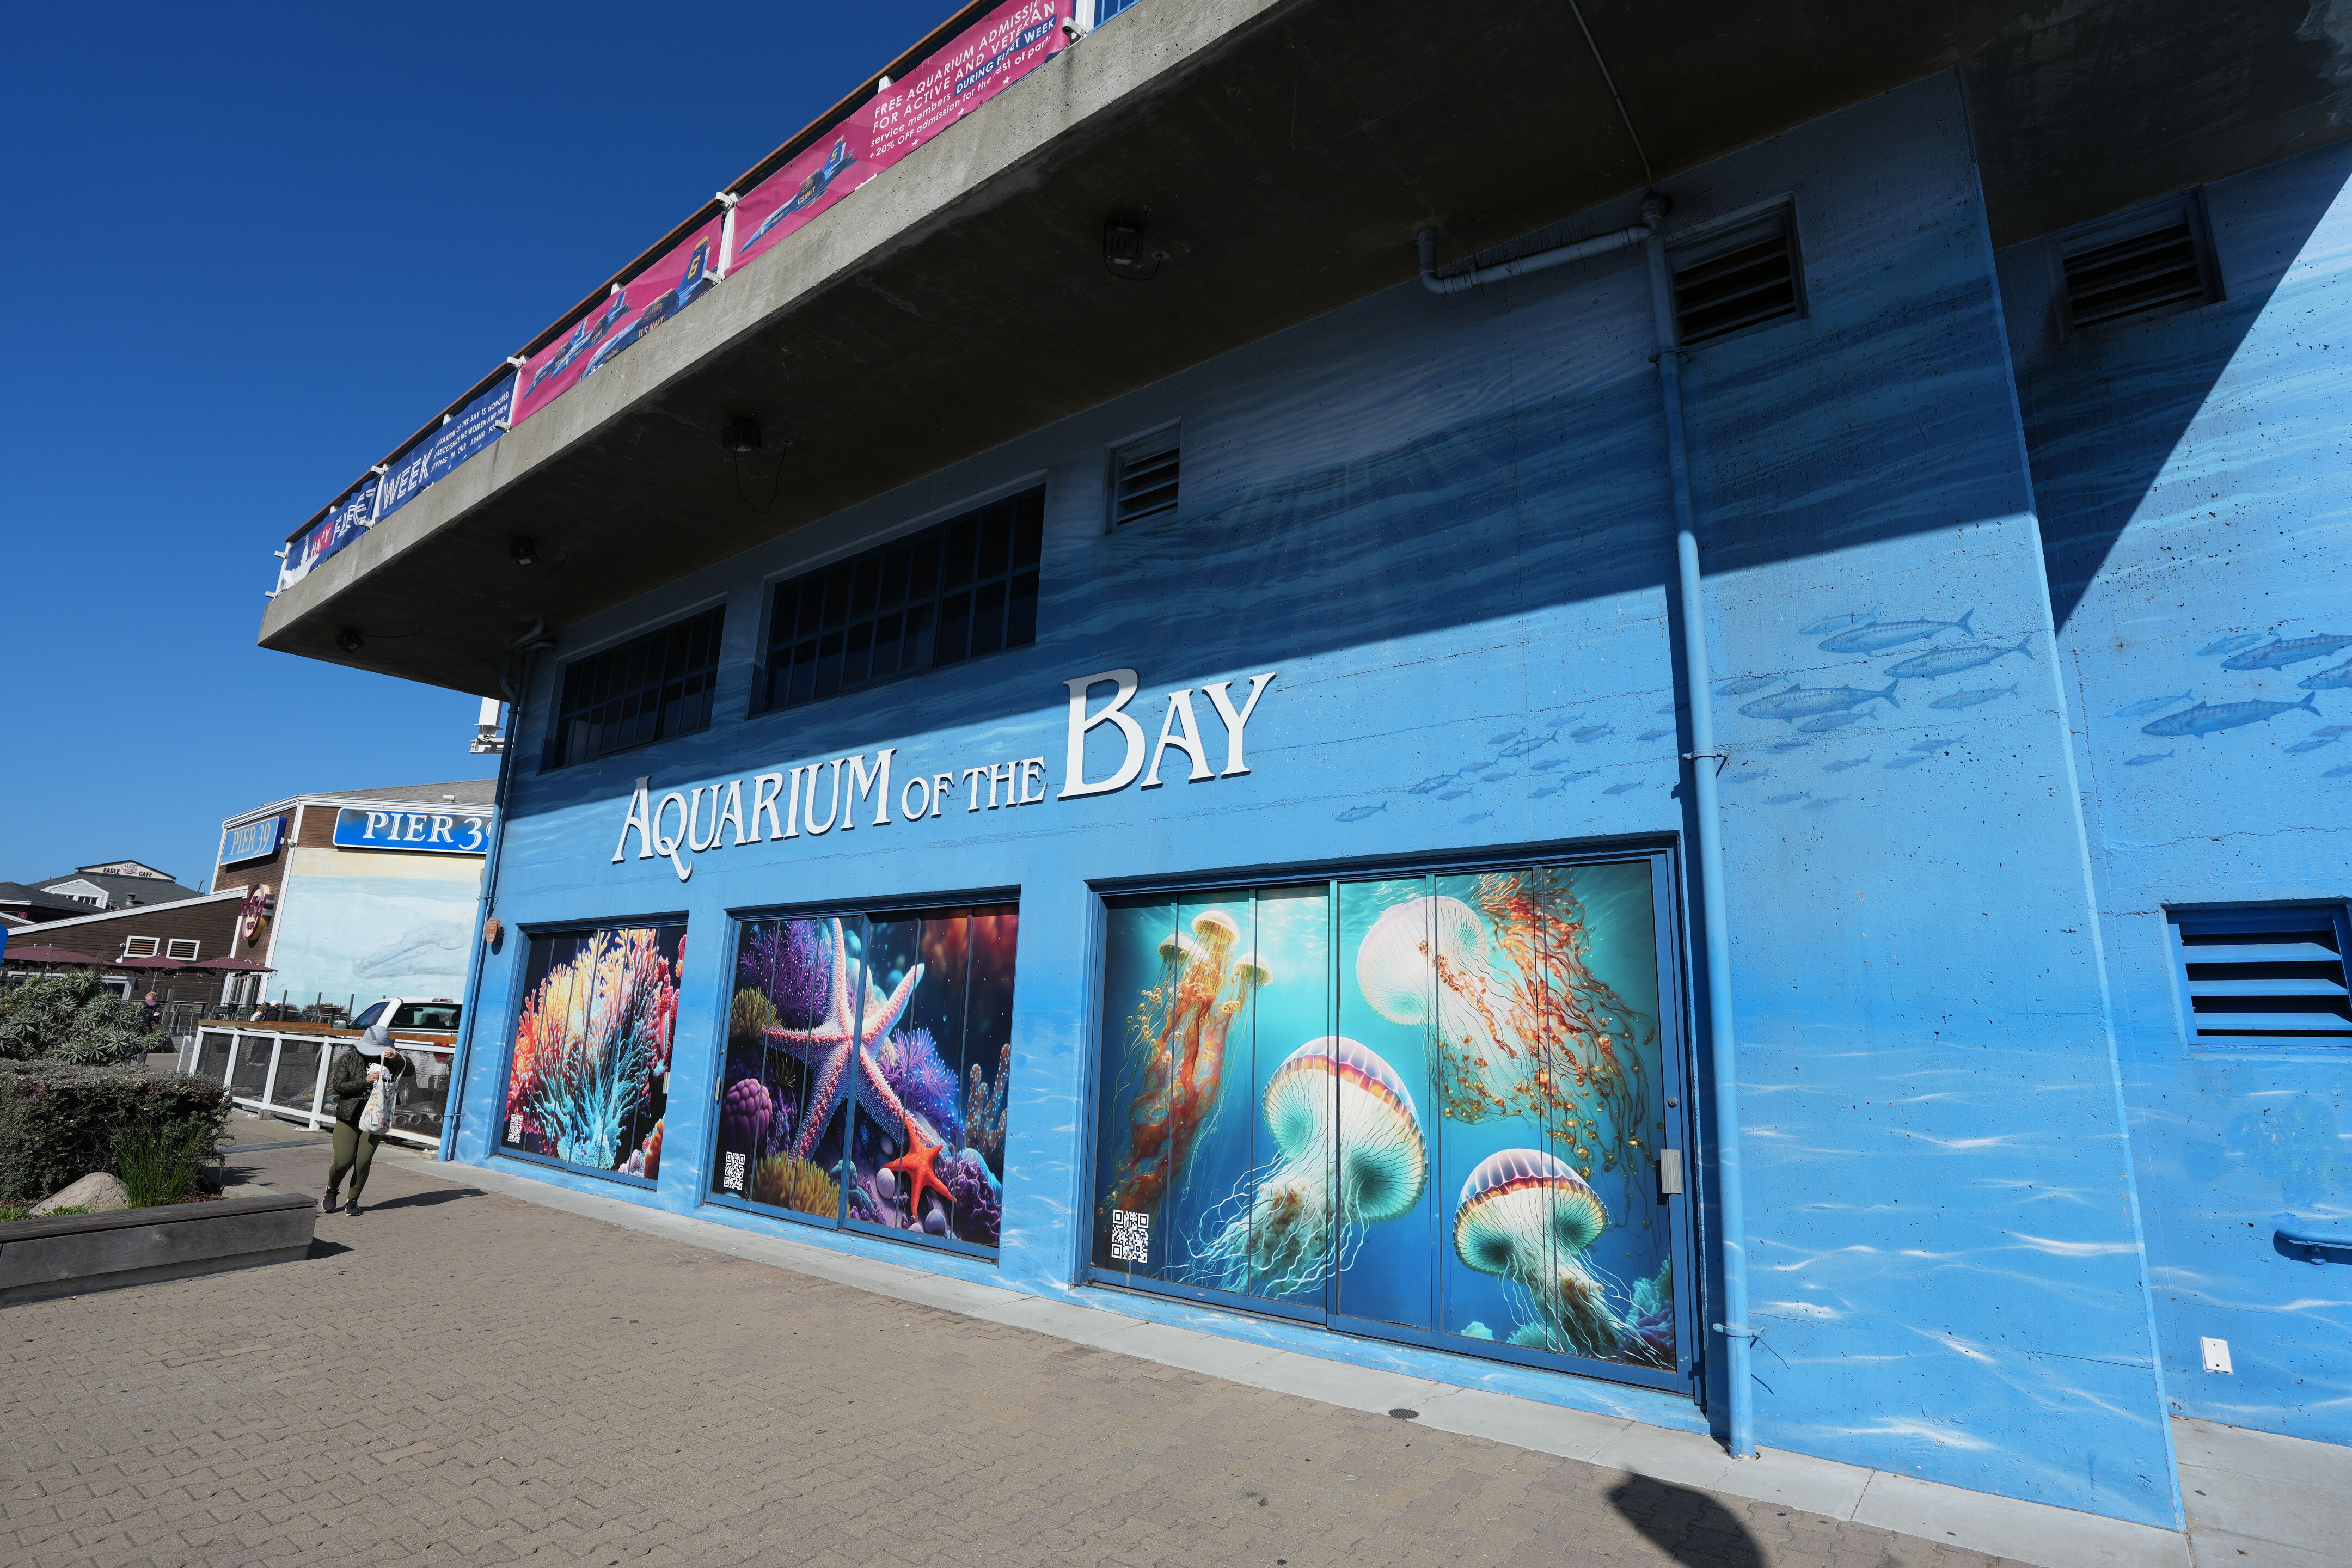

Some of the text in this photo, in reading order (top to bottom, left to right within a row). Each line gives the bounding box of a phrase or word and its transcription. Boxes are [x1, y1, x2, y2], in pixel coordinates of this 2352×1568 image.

[871, 17, 1054, 147] service members DURING FLEET WEEK
[873, 1, 1054, 133] FOR ACTIVE AND VETERAN
[875, 95, 903, 119] FREE
[906, 45, 974, 102] AQUARIUM
[875, 140, 895, 157] 20%
[897, 129, 914, 144] OFF
[916, 99, 960, 133] admission
[963, 88, 975, 102] for
[978, 77, 991, 91] the
[1015, 50, 1025, 65] of
[829, 147, 839, 163] 5
[688, 254, 700, 279] 6
[437, 436, 461, 456] RECOGNIZE
[468, 419, 487, 435] WOMEN
[487, 412, 497, 424] AND
[497, 403, 507, 416] MEN
[450, 451, 455, 460] IN
[458, 443, 467, 454] OUR
[470, 431, 486, 446] ARMED
[488, 416, 505, 433] FOES
[456, 424, 461, 433] OF
[470, 411, 480, 422] BAY
[481, 407, 486, 416] IS
[488, 391, 509, 412] HONORED
[383, 448, 433, 510] WEEK
[611, 667, 1277, 881] AQUARIUM OF THE BAY
[229, 822, 271, 855] PIER 39
[363, 812, 491, 851] PIER 3
